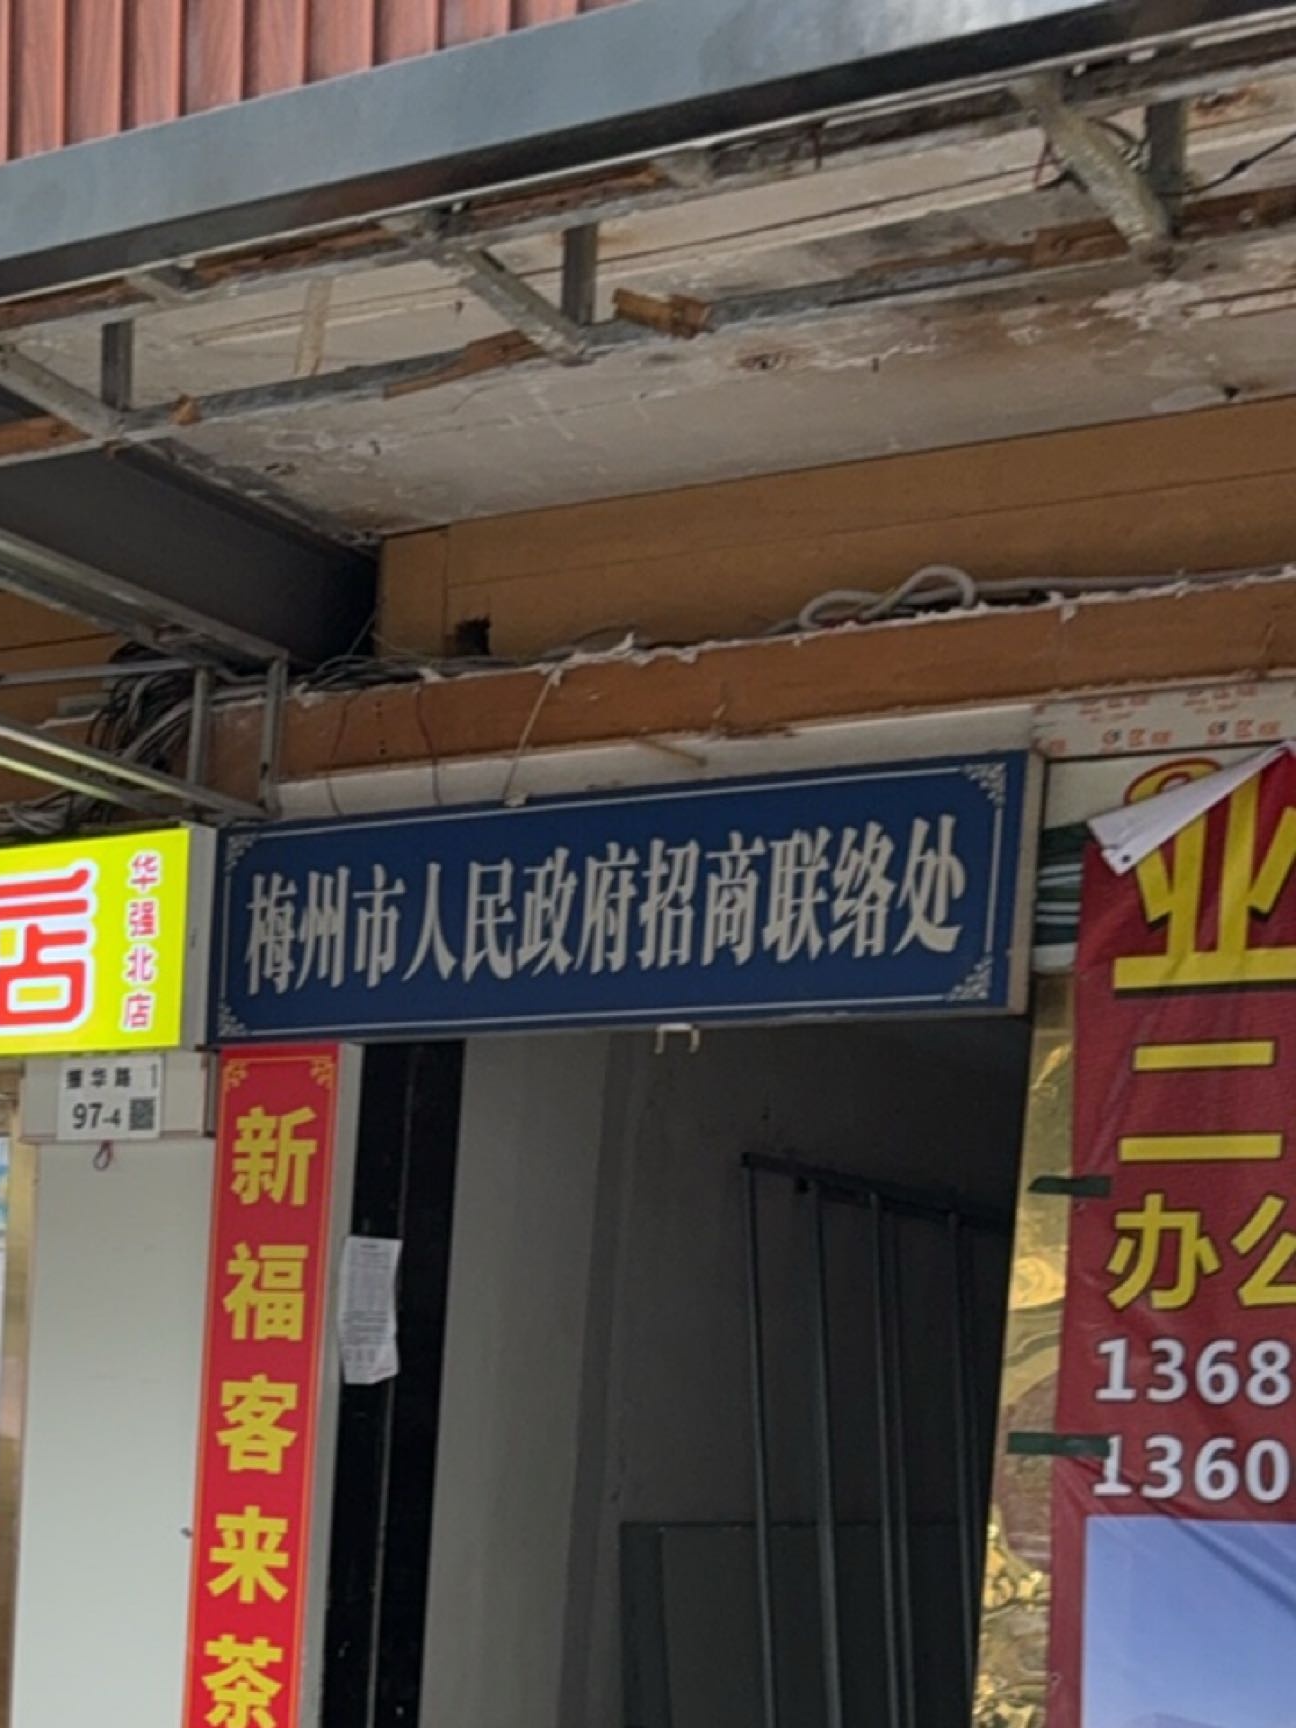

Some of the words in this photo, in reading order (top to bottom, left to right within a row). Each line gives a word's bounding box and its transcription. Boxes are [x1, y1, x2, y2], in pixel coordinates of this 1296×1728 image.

[245, 813, 968, 996] 梅州市人民政府招商联络处
[122, 854, 158, 1029] 华强北店
[72, 1102, 121, 1130] 97-4
[1094, 1337, 1292, 1405] 1368
[1092, 1433, 1291, 1503] 1360
